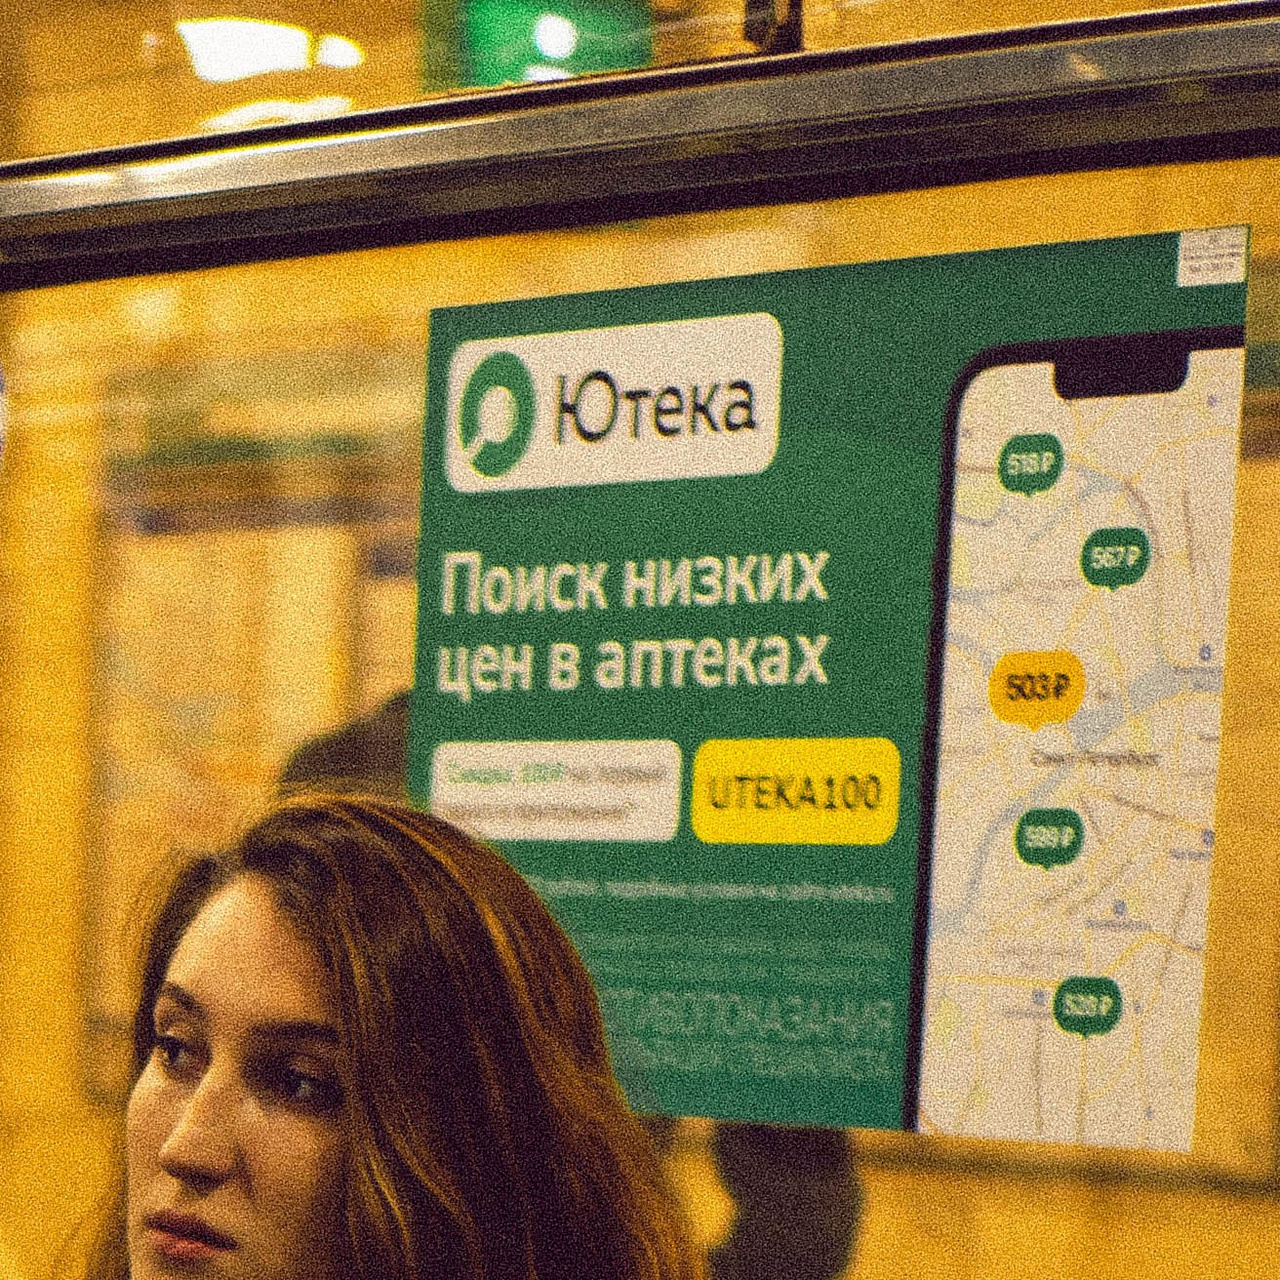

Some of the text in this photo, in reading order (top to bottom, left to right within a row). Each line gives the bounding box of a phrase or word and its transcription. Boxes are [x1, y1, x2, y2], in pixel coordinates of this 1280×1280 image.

[556, 369, 756, 446] Ютека
[441, 550, 830, 616] Поиск низких
[436, 636, 830, 701] цен в аптеках
[709, 774, 882, 812] UTEKA100
